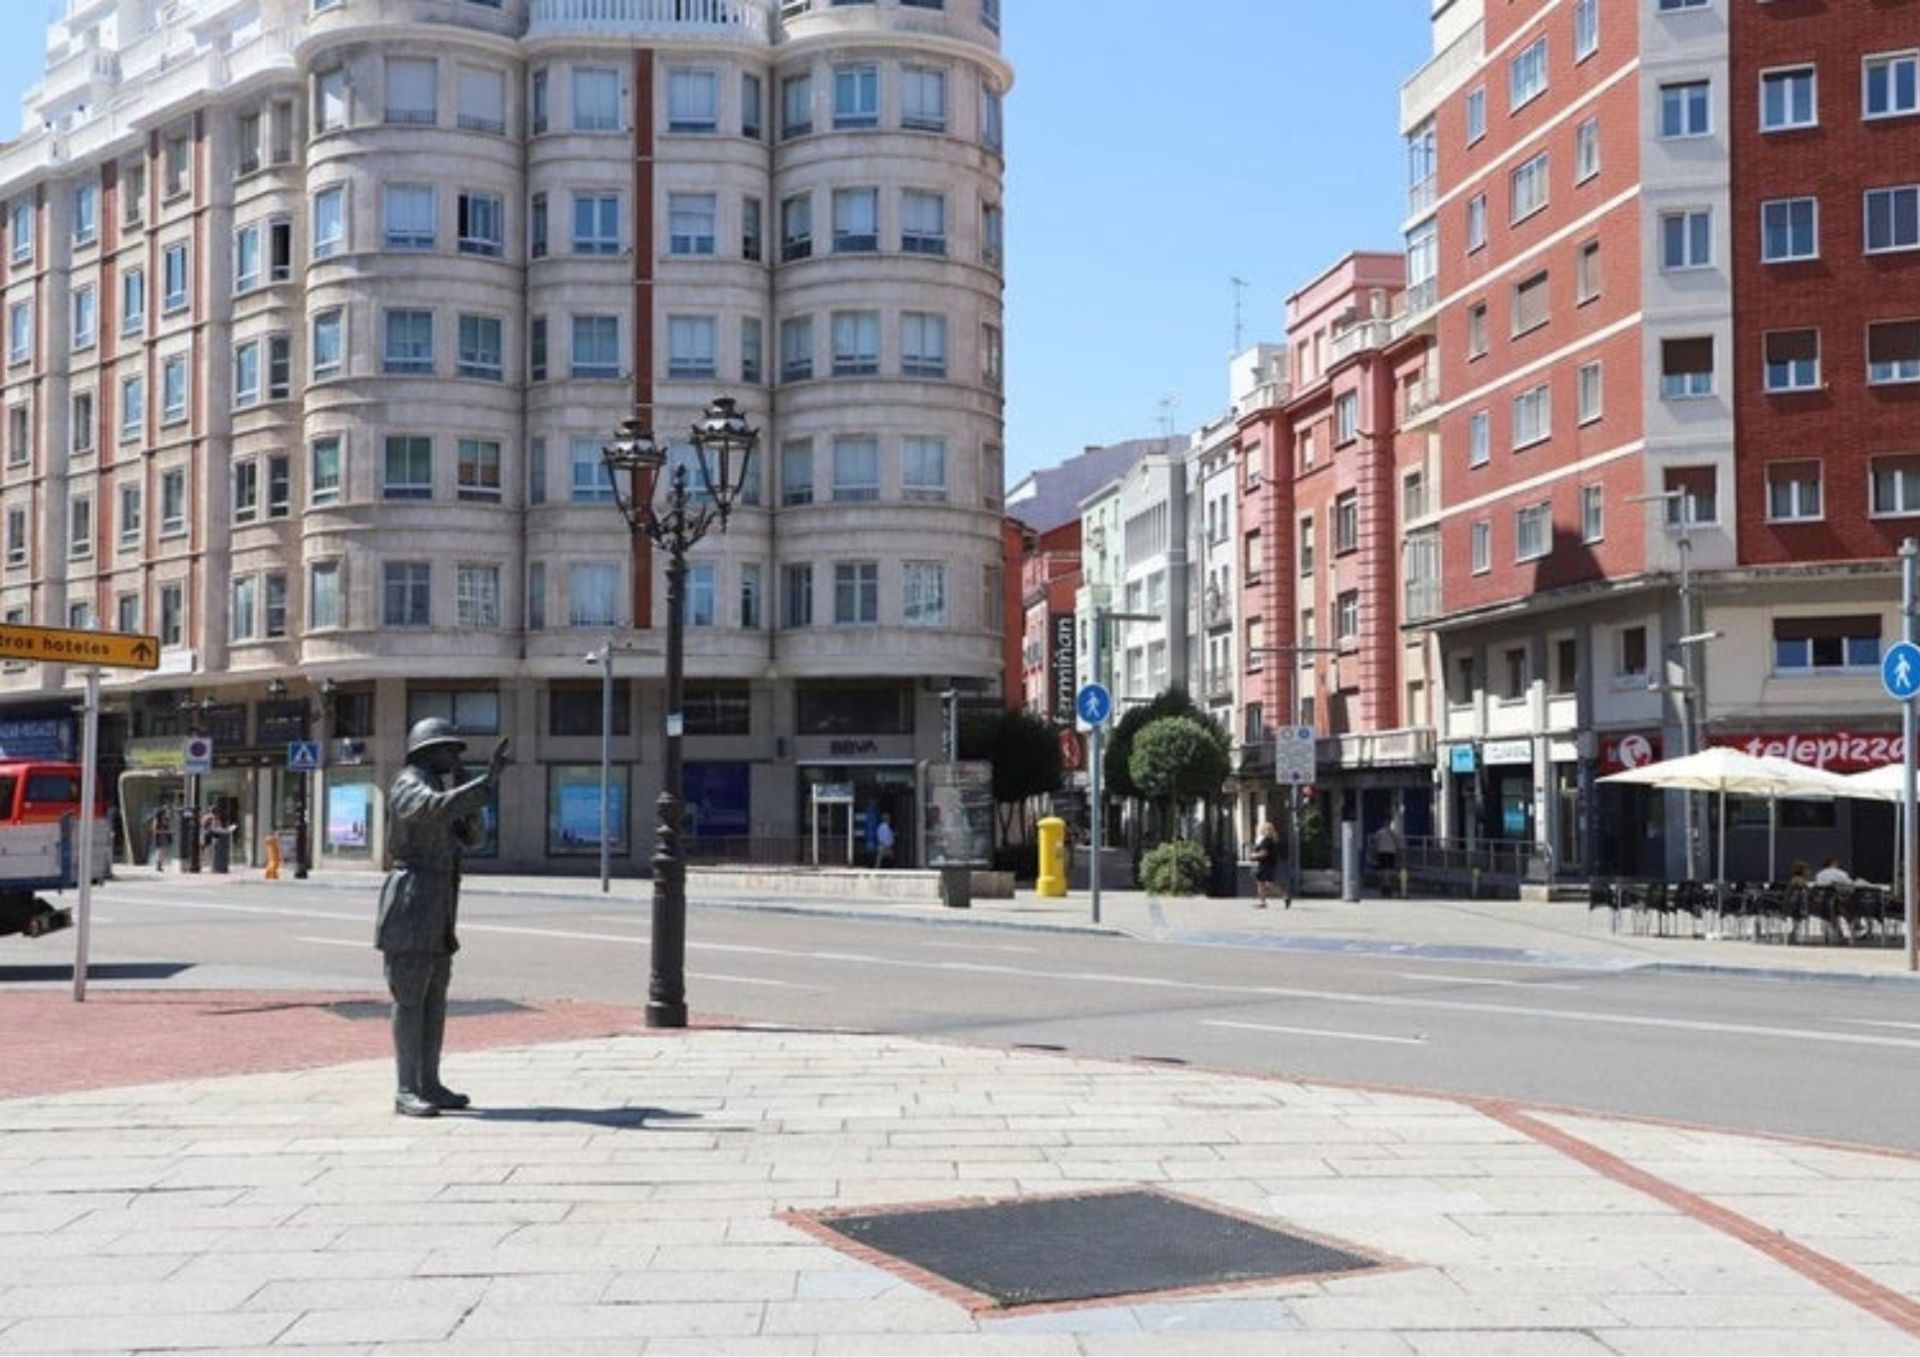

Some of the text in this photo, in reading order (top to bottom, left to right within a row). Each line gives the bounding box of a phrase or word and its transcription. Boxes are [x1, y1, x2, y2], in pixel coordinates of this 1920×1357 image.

[43, 634, 110, 655] hoteles
[830, 739, 878, 755] BBVA
[1745, 732, 1905, 768] telepizza
